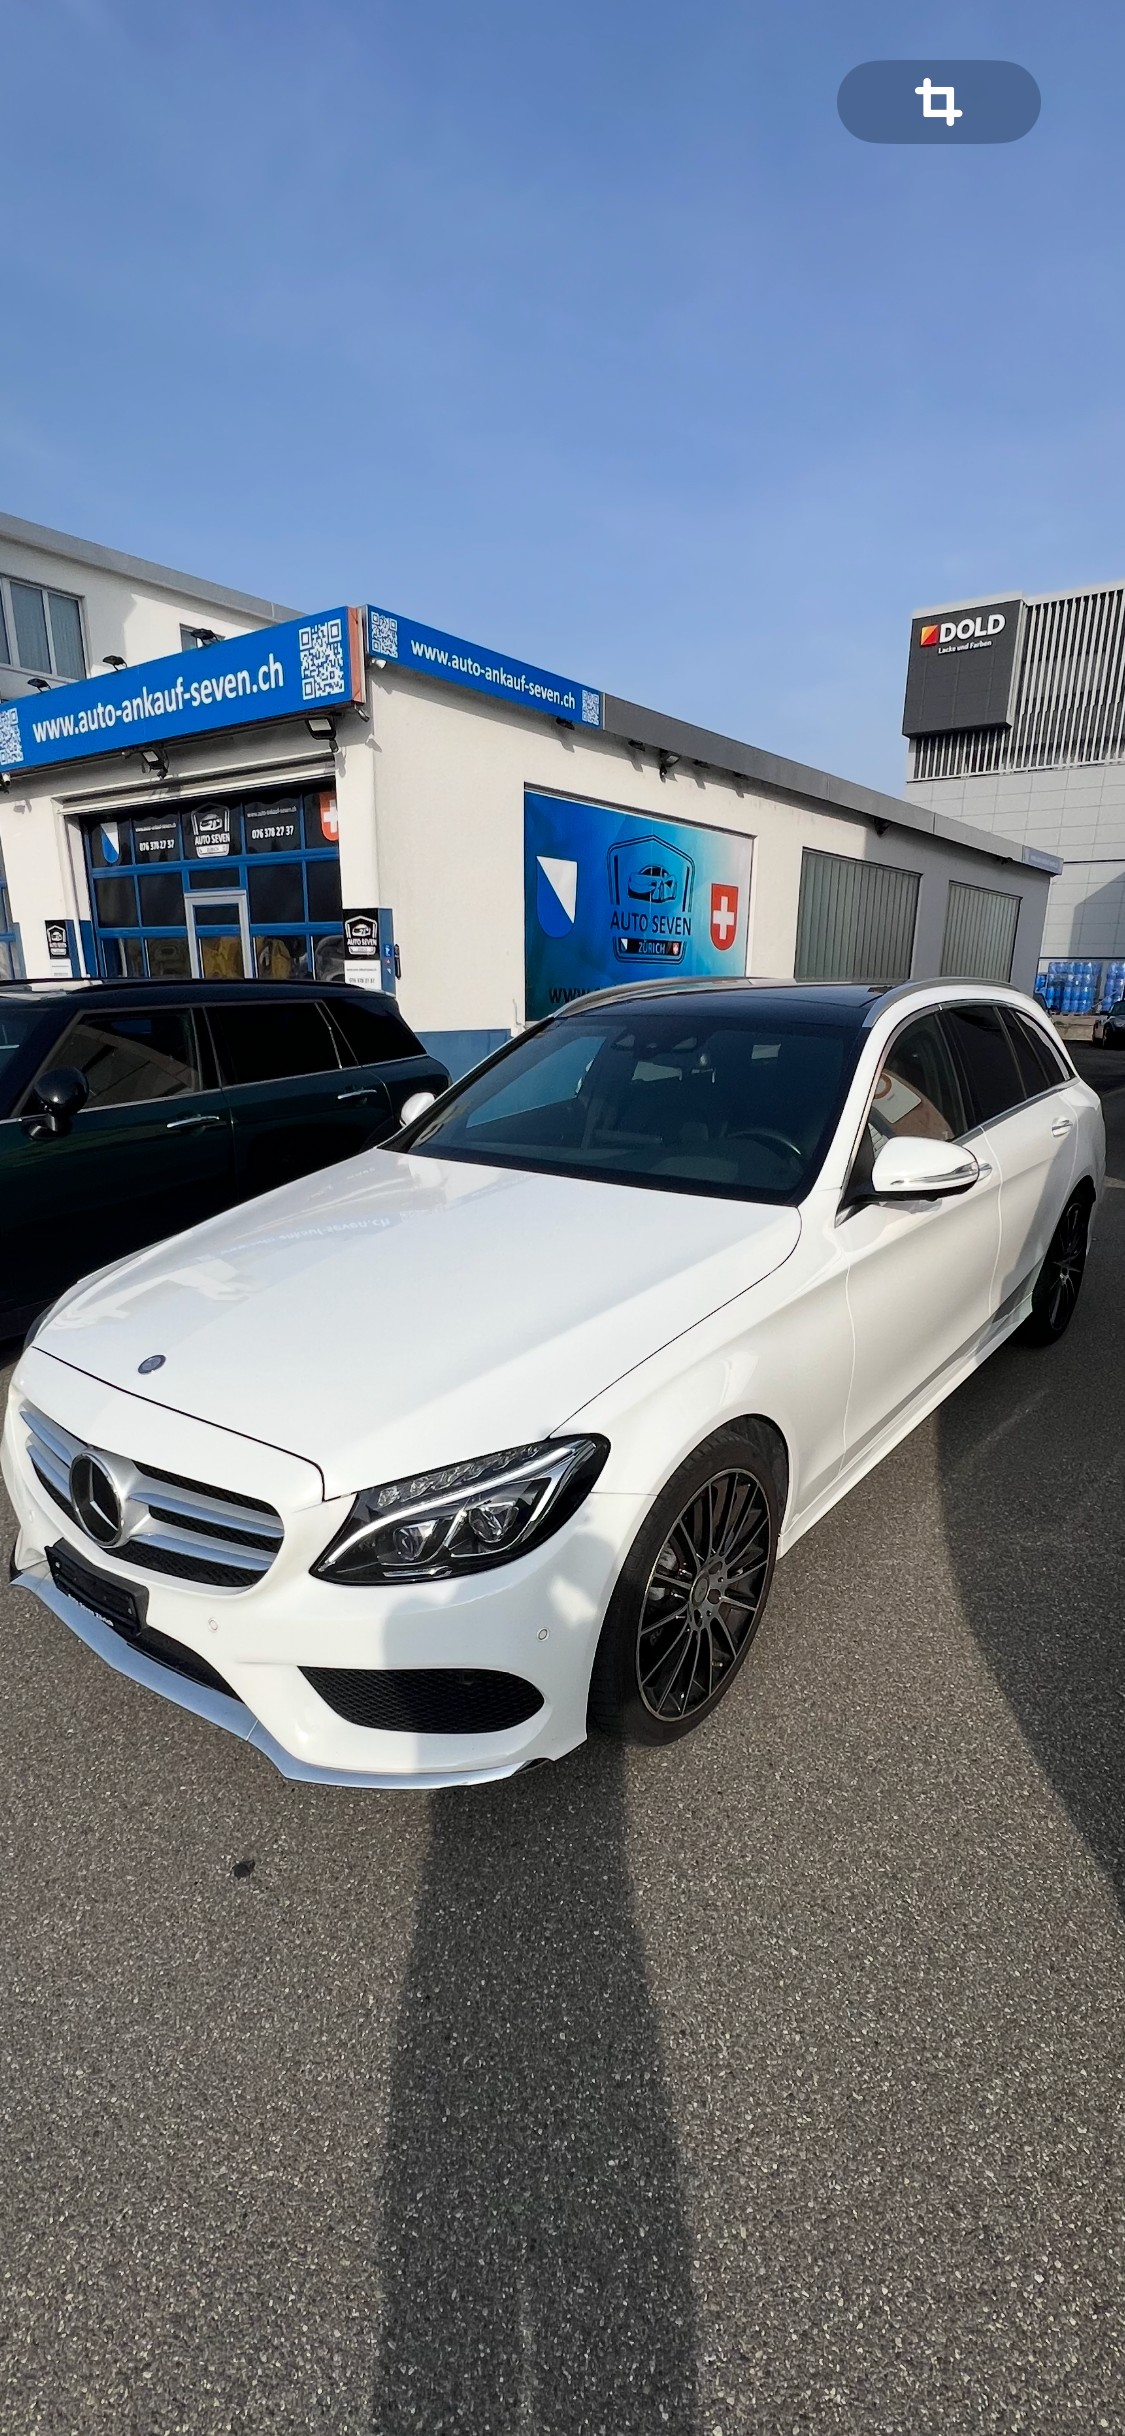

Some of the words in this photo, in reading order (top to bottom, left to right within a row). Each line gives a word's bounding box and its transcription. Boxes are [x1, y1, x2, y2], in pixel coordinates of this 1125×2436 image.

[939, 614, 1006, 643] DOLD
[938, 645, 957, 654] Lacke
[957, 643, 969, 651] und
[970, 640, 992, 649] Farben
[410, 639, 576, 710] www.auto-ankauf-seven.ch
[32, 652, 284, 743] www.auto-ankauf-seven.ch
[194, 834, 210, 846] AUTO
[211, 832, 231, 844] SEVEN
[251, 828, 264, 839] 076
[264, 827, 275, 838] 378
[276, 825, 285, 837] 27
[286, 825, 294, 836] 37
[610, 910, 648, 932] AUTO
[652, 914, 691, 936] SEVEN
[638, 940, 666, 955] ZÜRICH
